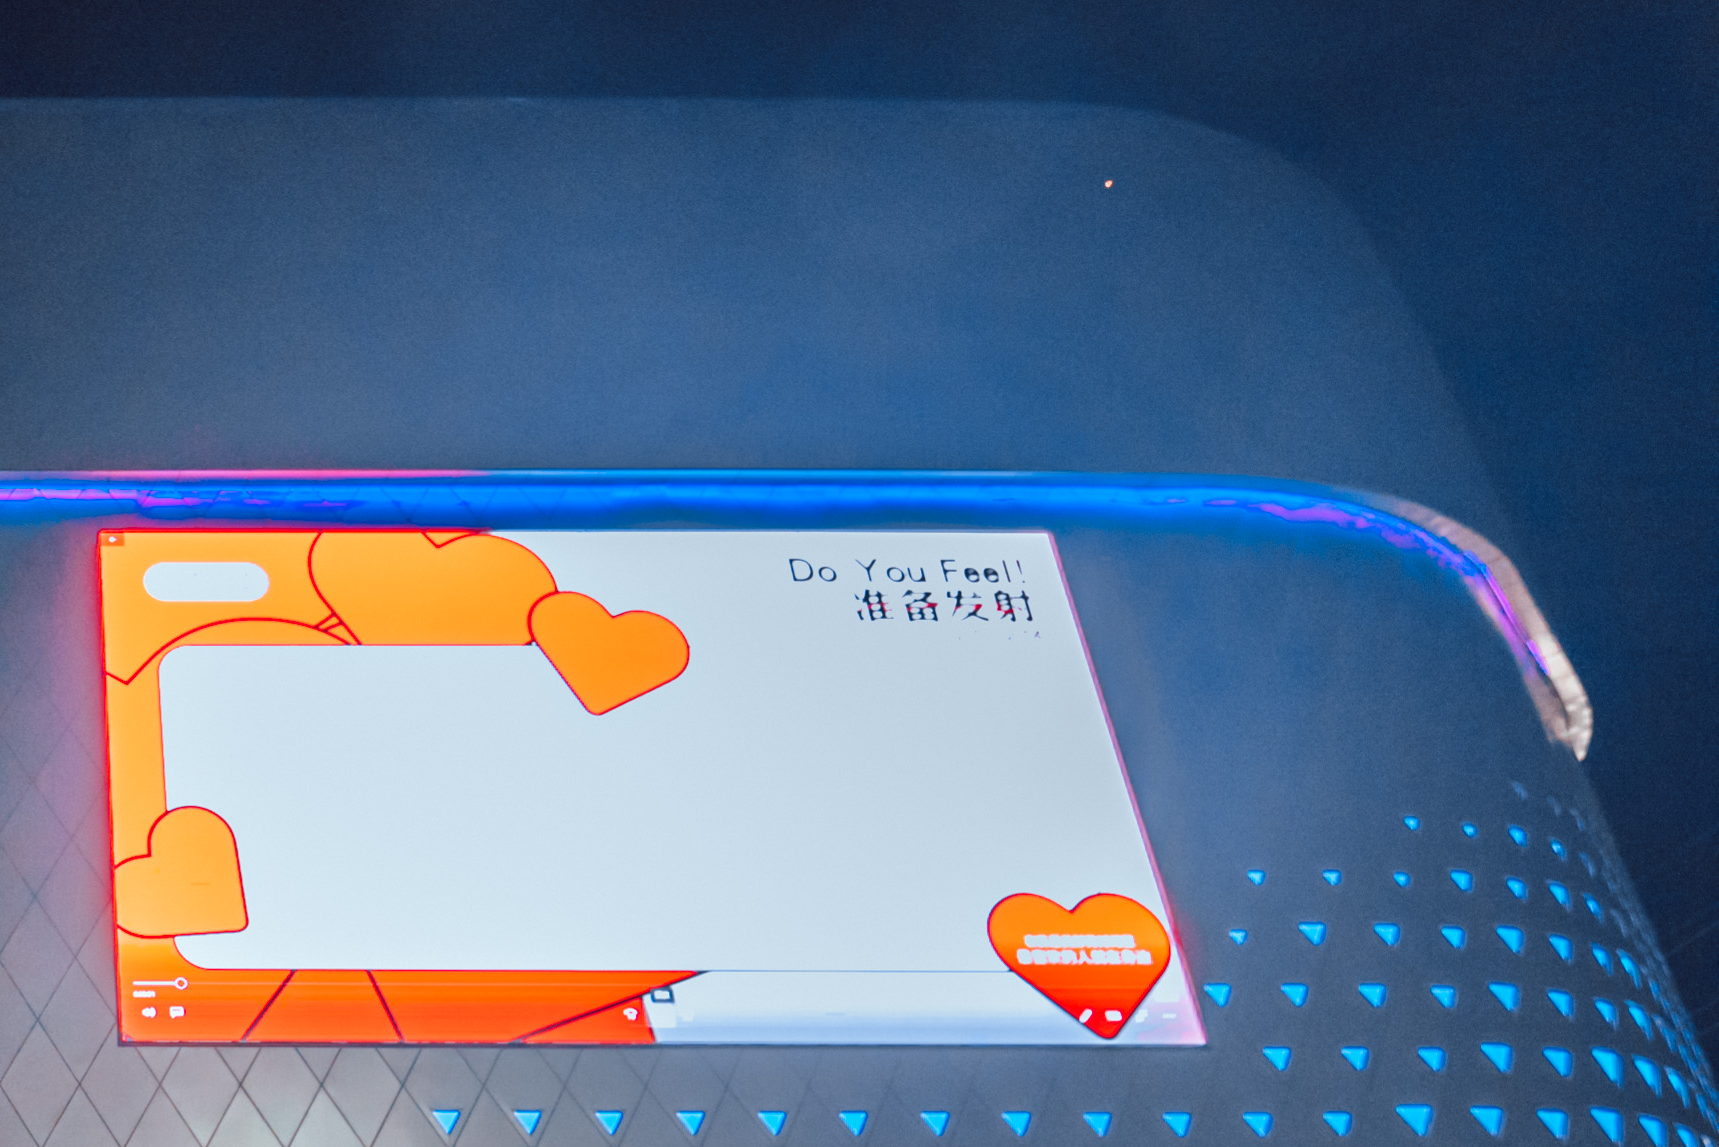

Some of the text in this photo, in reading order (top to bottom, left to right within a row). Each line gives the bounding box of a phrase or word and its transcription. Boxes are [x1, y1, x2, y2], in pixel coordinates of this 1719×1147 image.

[789, 558, 1027, 584] Do You Feel!
[854, 589, 1034, 622] 准备发射
